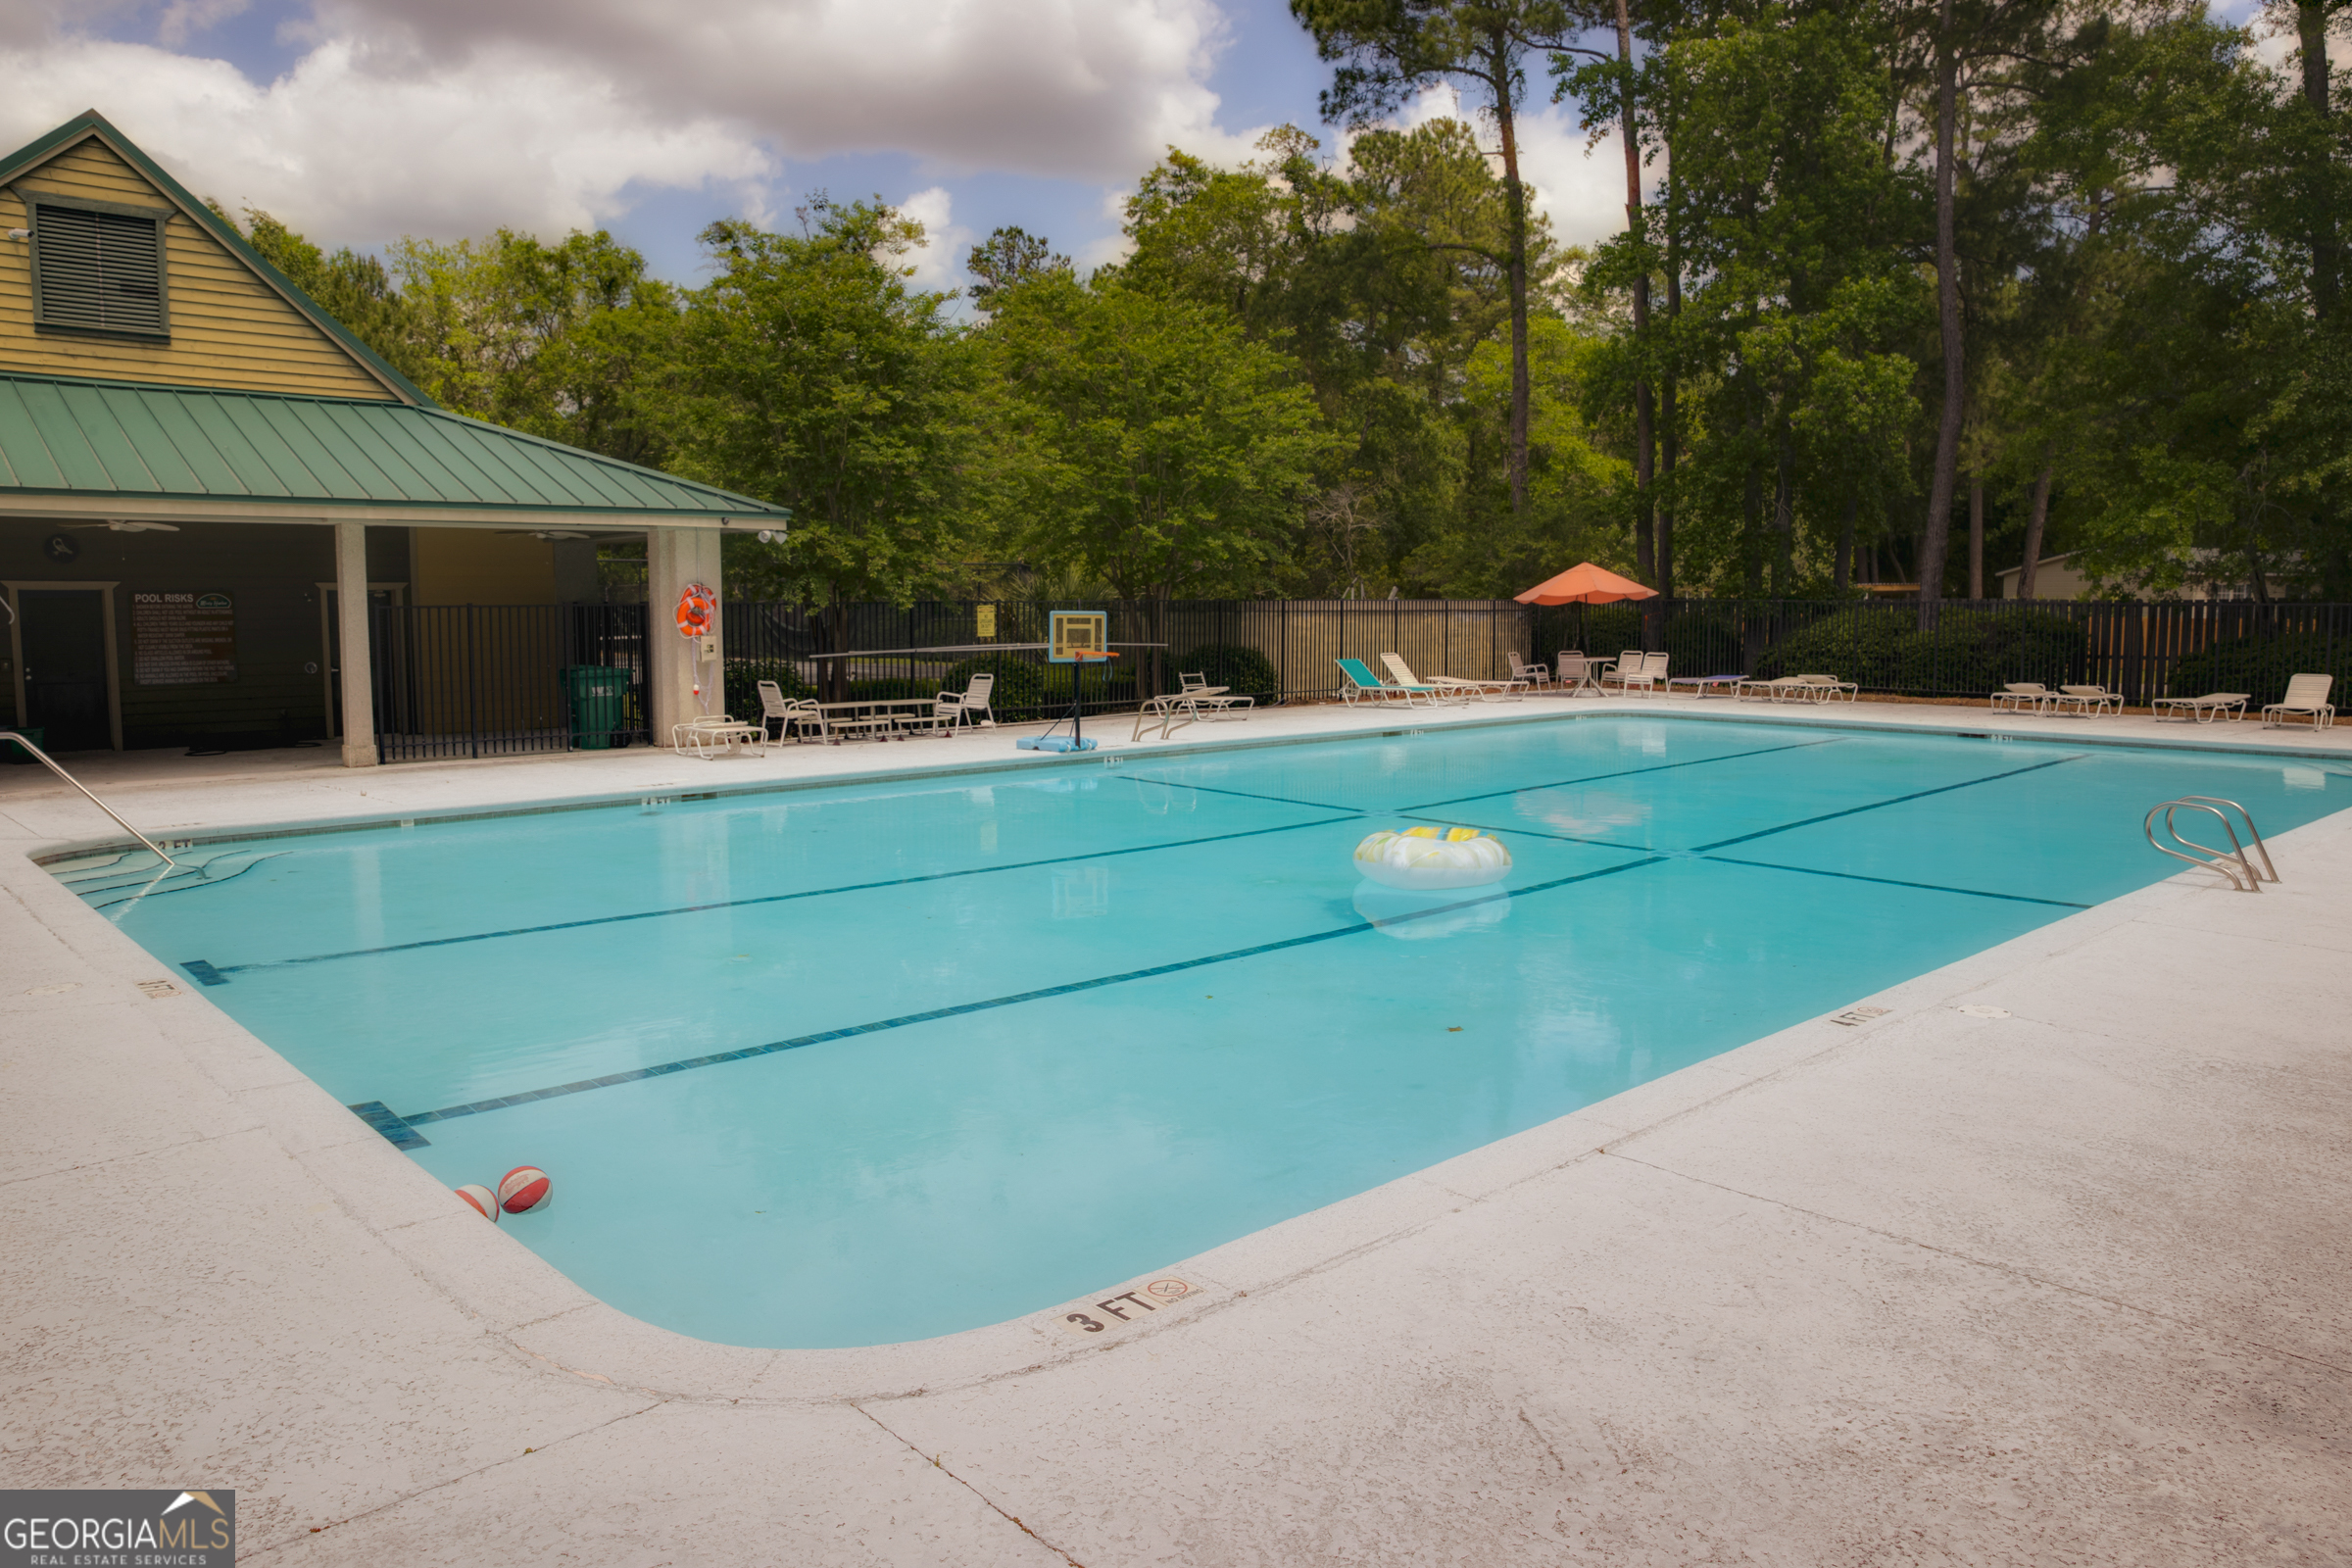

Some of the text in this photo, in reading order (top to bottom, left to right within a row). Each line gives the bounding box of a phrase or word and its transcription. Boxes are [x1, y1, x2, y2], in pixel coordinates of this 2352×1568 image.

[135, 594, 194, 602] POOL RISKS
[1177, 1289, 1204, 1299] DIVING
[1066, 1291, 1156, 1333] 3 FT
